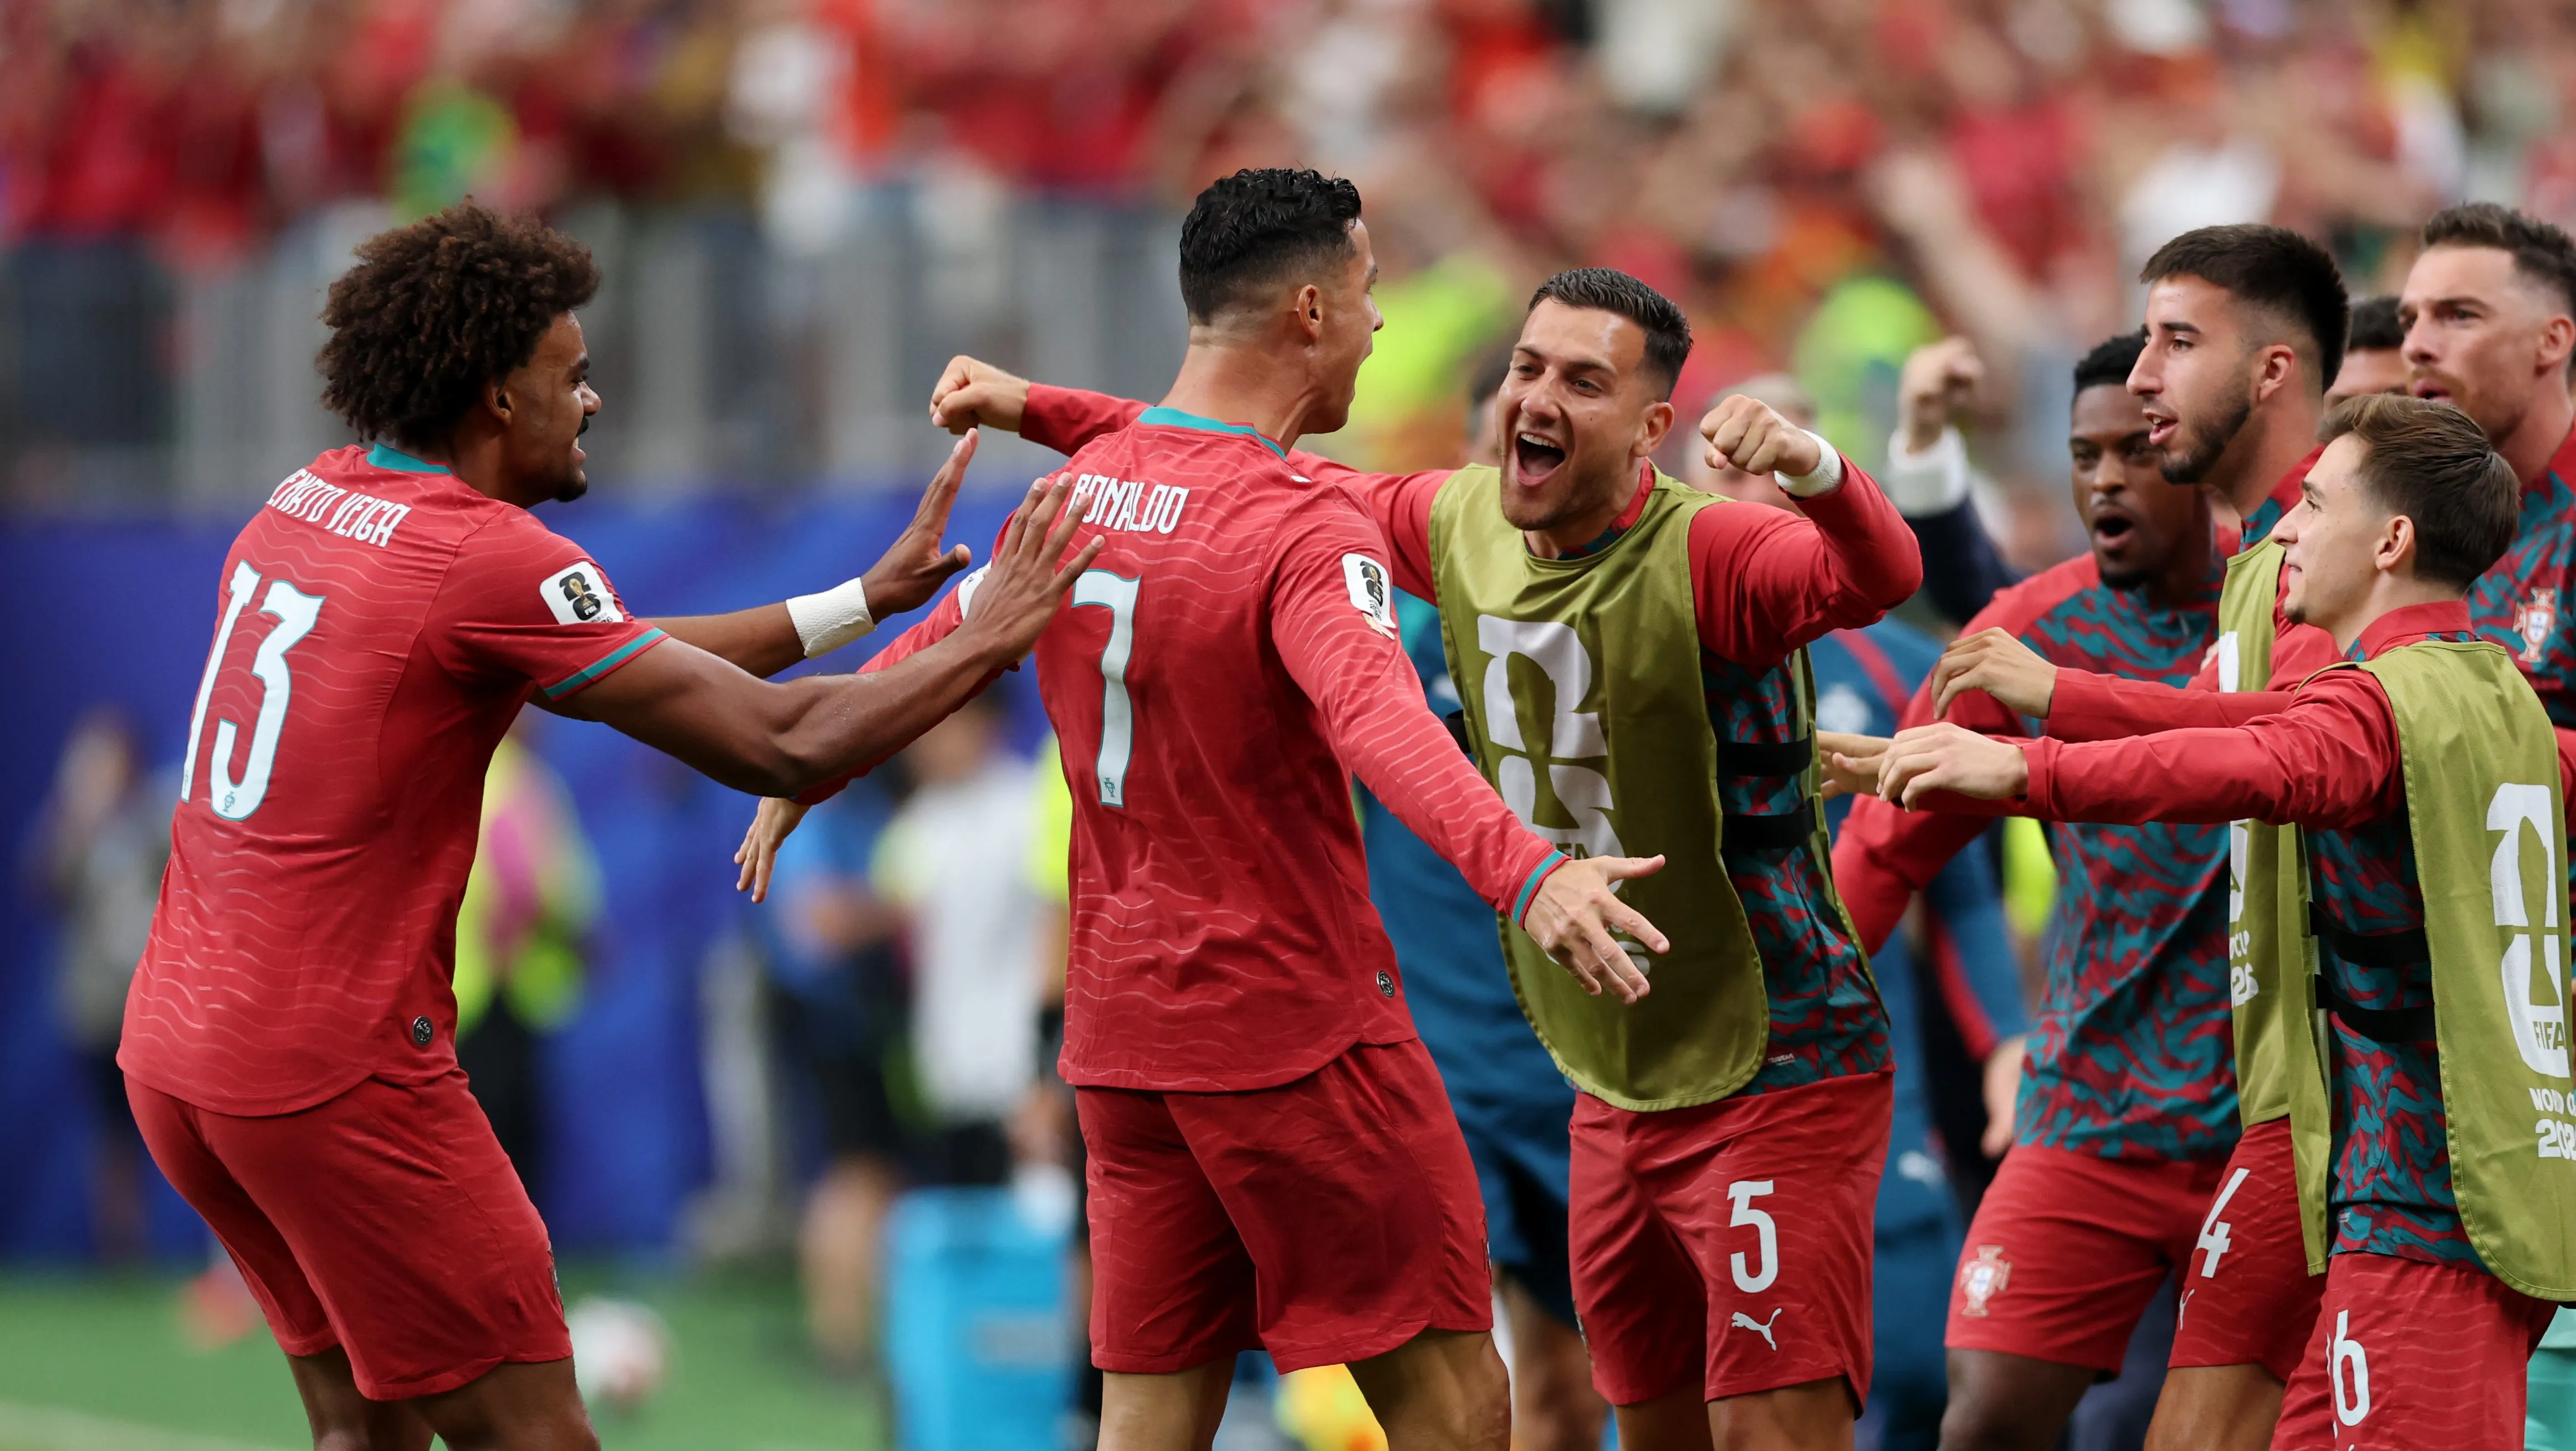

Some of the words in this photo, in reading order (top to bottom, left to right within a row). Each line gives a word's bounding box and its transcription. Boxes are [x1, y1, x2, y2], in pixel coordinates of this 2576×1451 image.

[266, 468, 348, 522] ENATO
[324, 493, 412, 547] VEIGA
[1065, 474, 1189, 534] RONALDO
[181, 559, 326, 821] 13
[1071, 569, 1142, 808] 7
[2532, 1021, 2567, 1050] FIFA
[2535, 1118, 2576, 1161] 202
[1726, 1179, 1779, 1293] 5
[2196, 1167, 2250, 1278] 4
